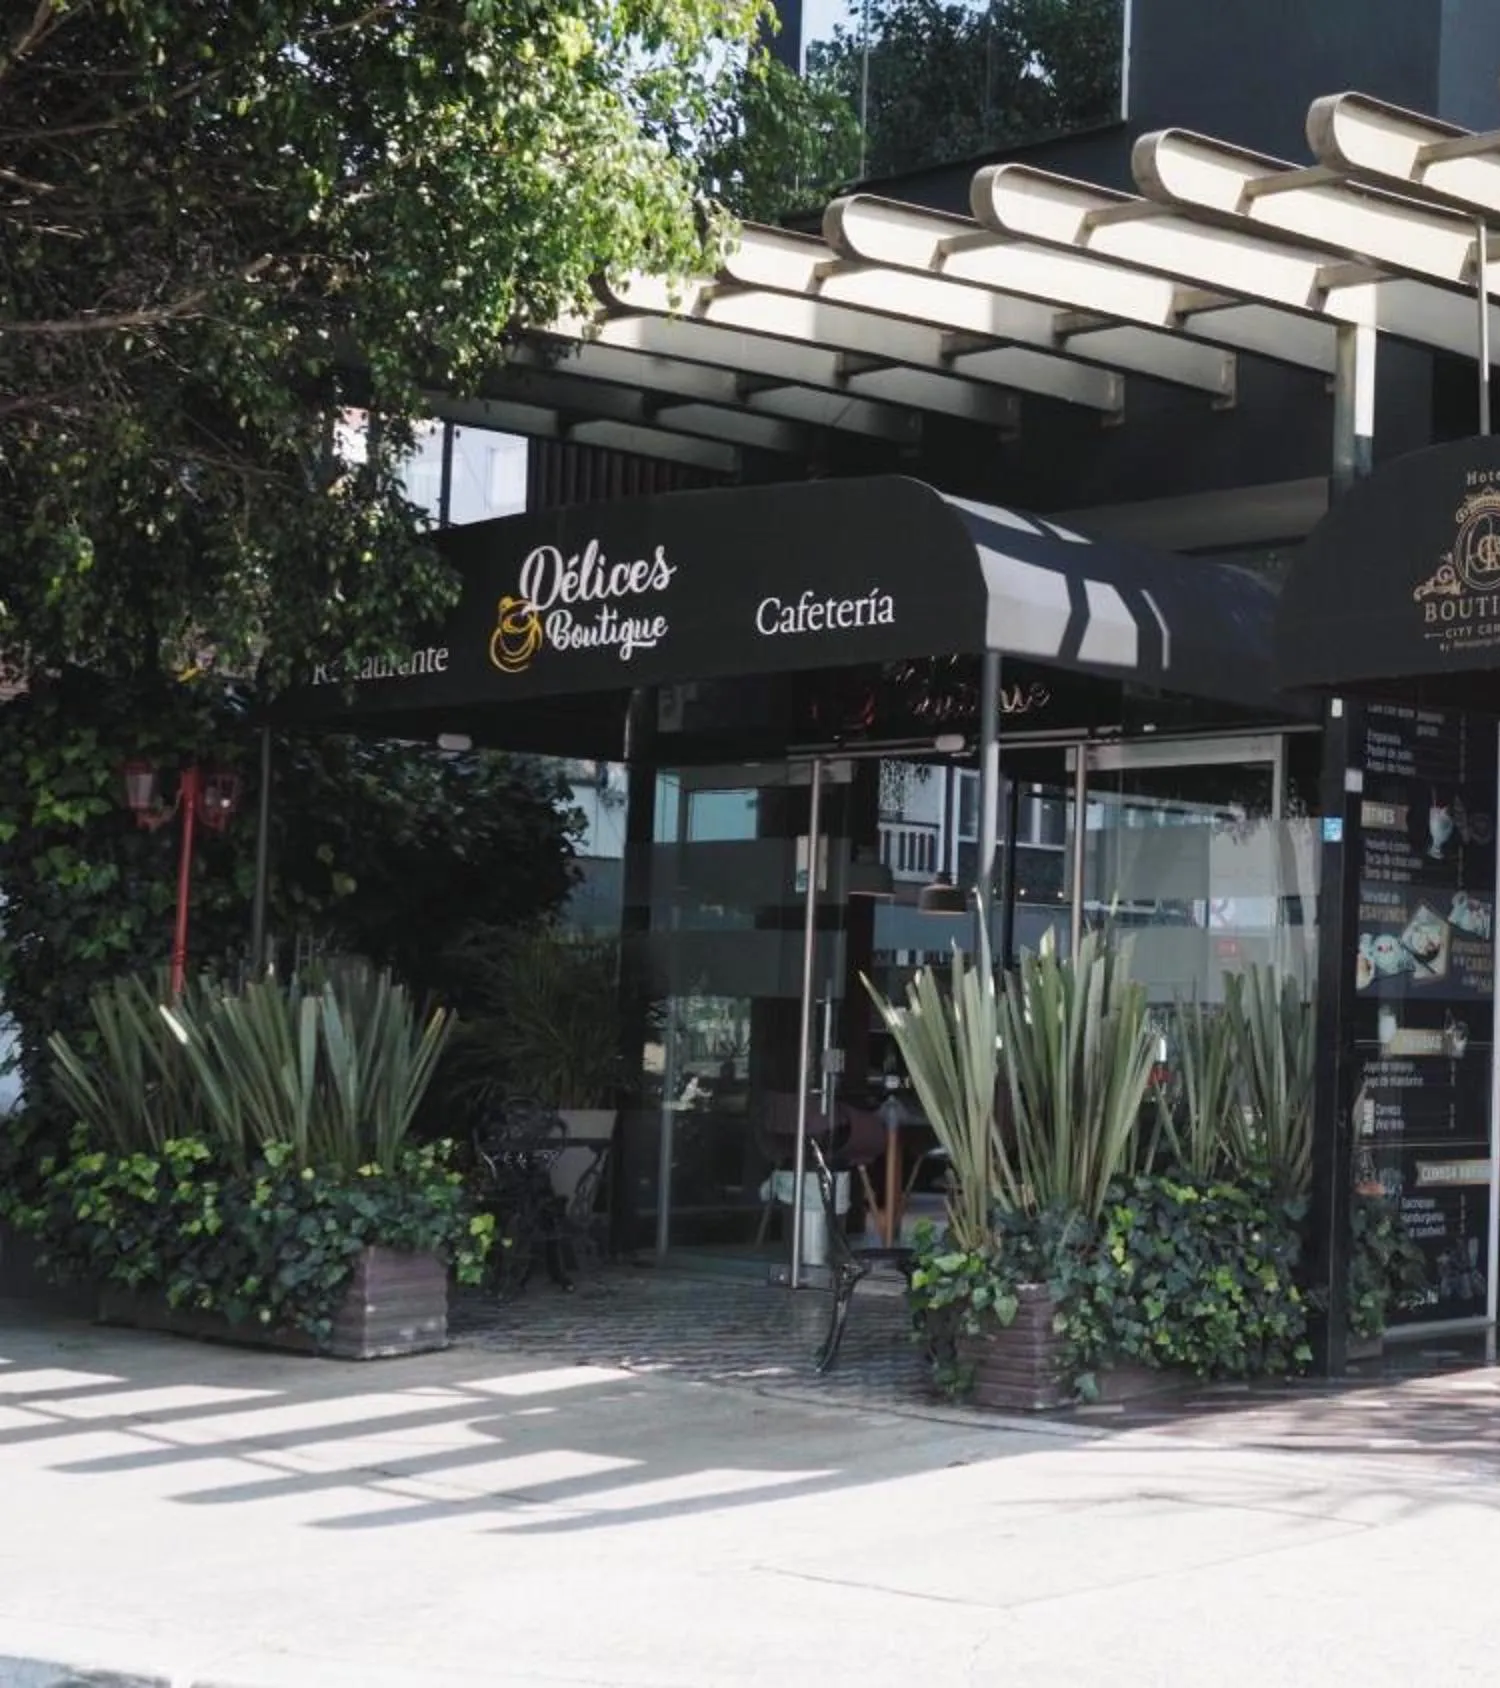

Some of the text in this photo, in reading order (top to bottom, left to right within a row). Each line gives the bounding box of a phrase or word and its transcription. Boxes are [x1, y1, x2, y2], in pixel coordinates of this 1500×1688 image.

[519, 539, 678, 611] Délices
[545, 609, 670, 661] Boutique
[755, 588, 896, 636] Cafetería
[1445, 625, 1473, 639] CITY
[312, 646, 449, 686] Raurnte
